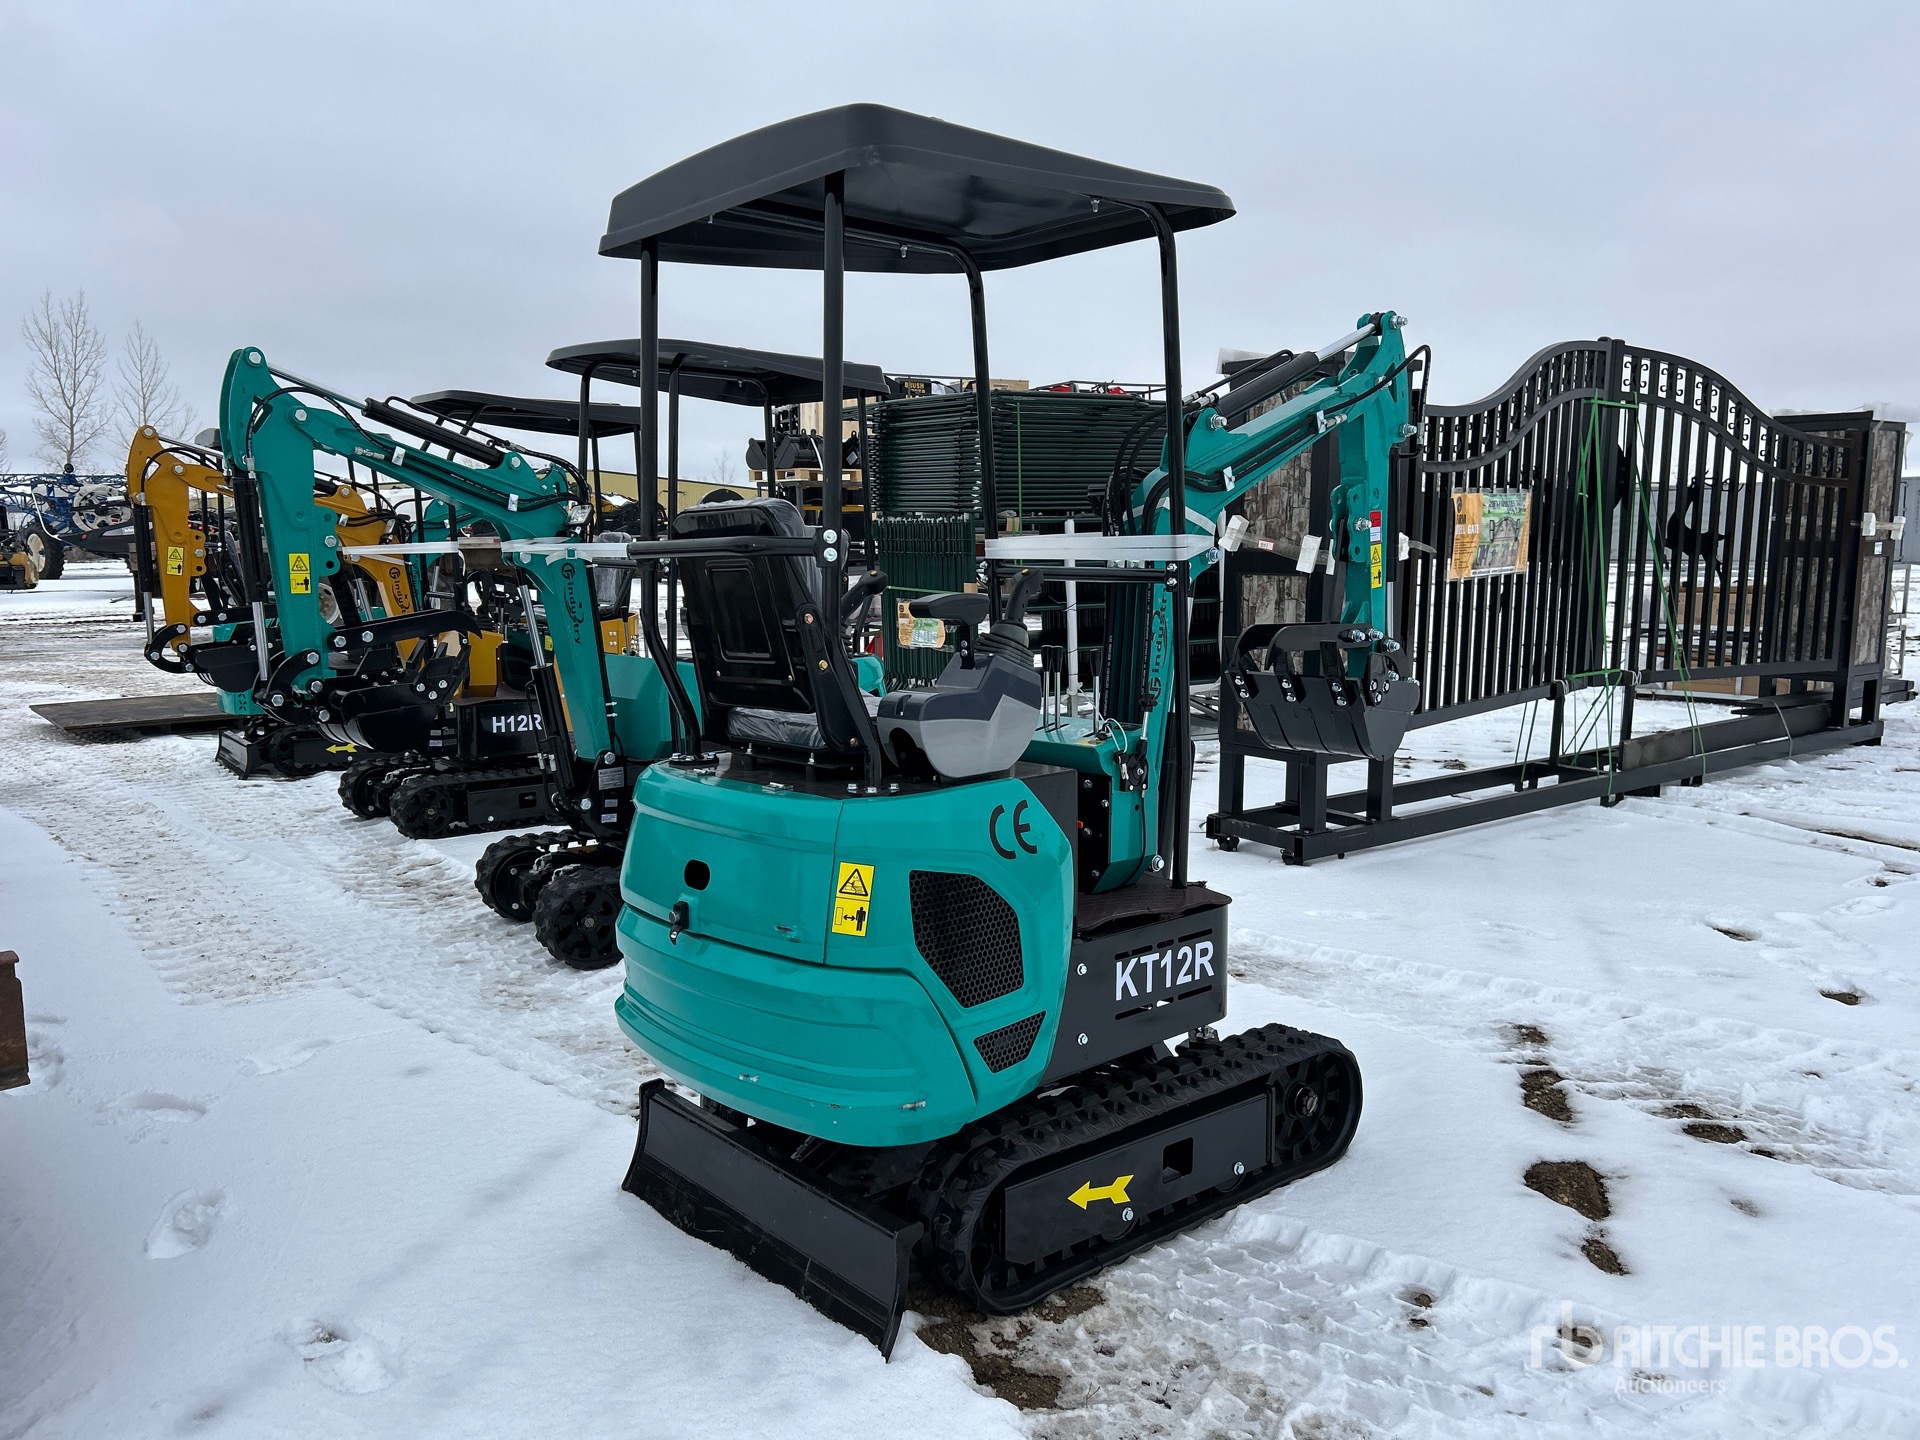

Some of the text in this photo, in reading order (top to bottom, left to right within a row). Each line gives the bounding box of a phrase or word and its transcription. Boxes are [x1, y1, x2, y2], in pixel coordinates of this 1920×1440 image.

[1467, 524, 1480, 534] GATE
[988, 799, 1038, 860] CE
[1115, 940, 1215, 1001] KT12R
